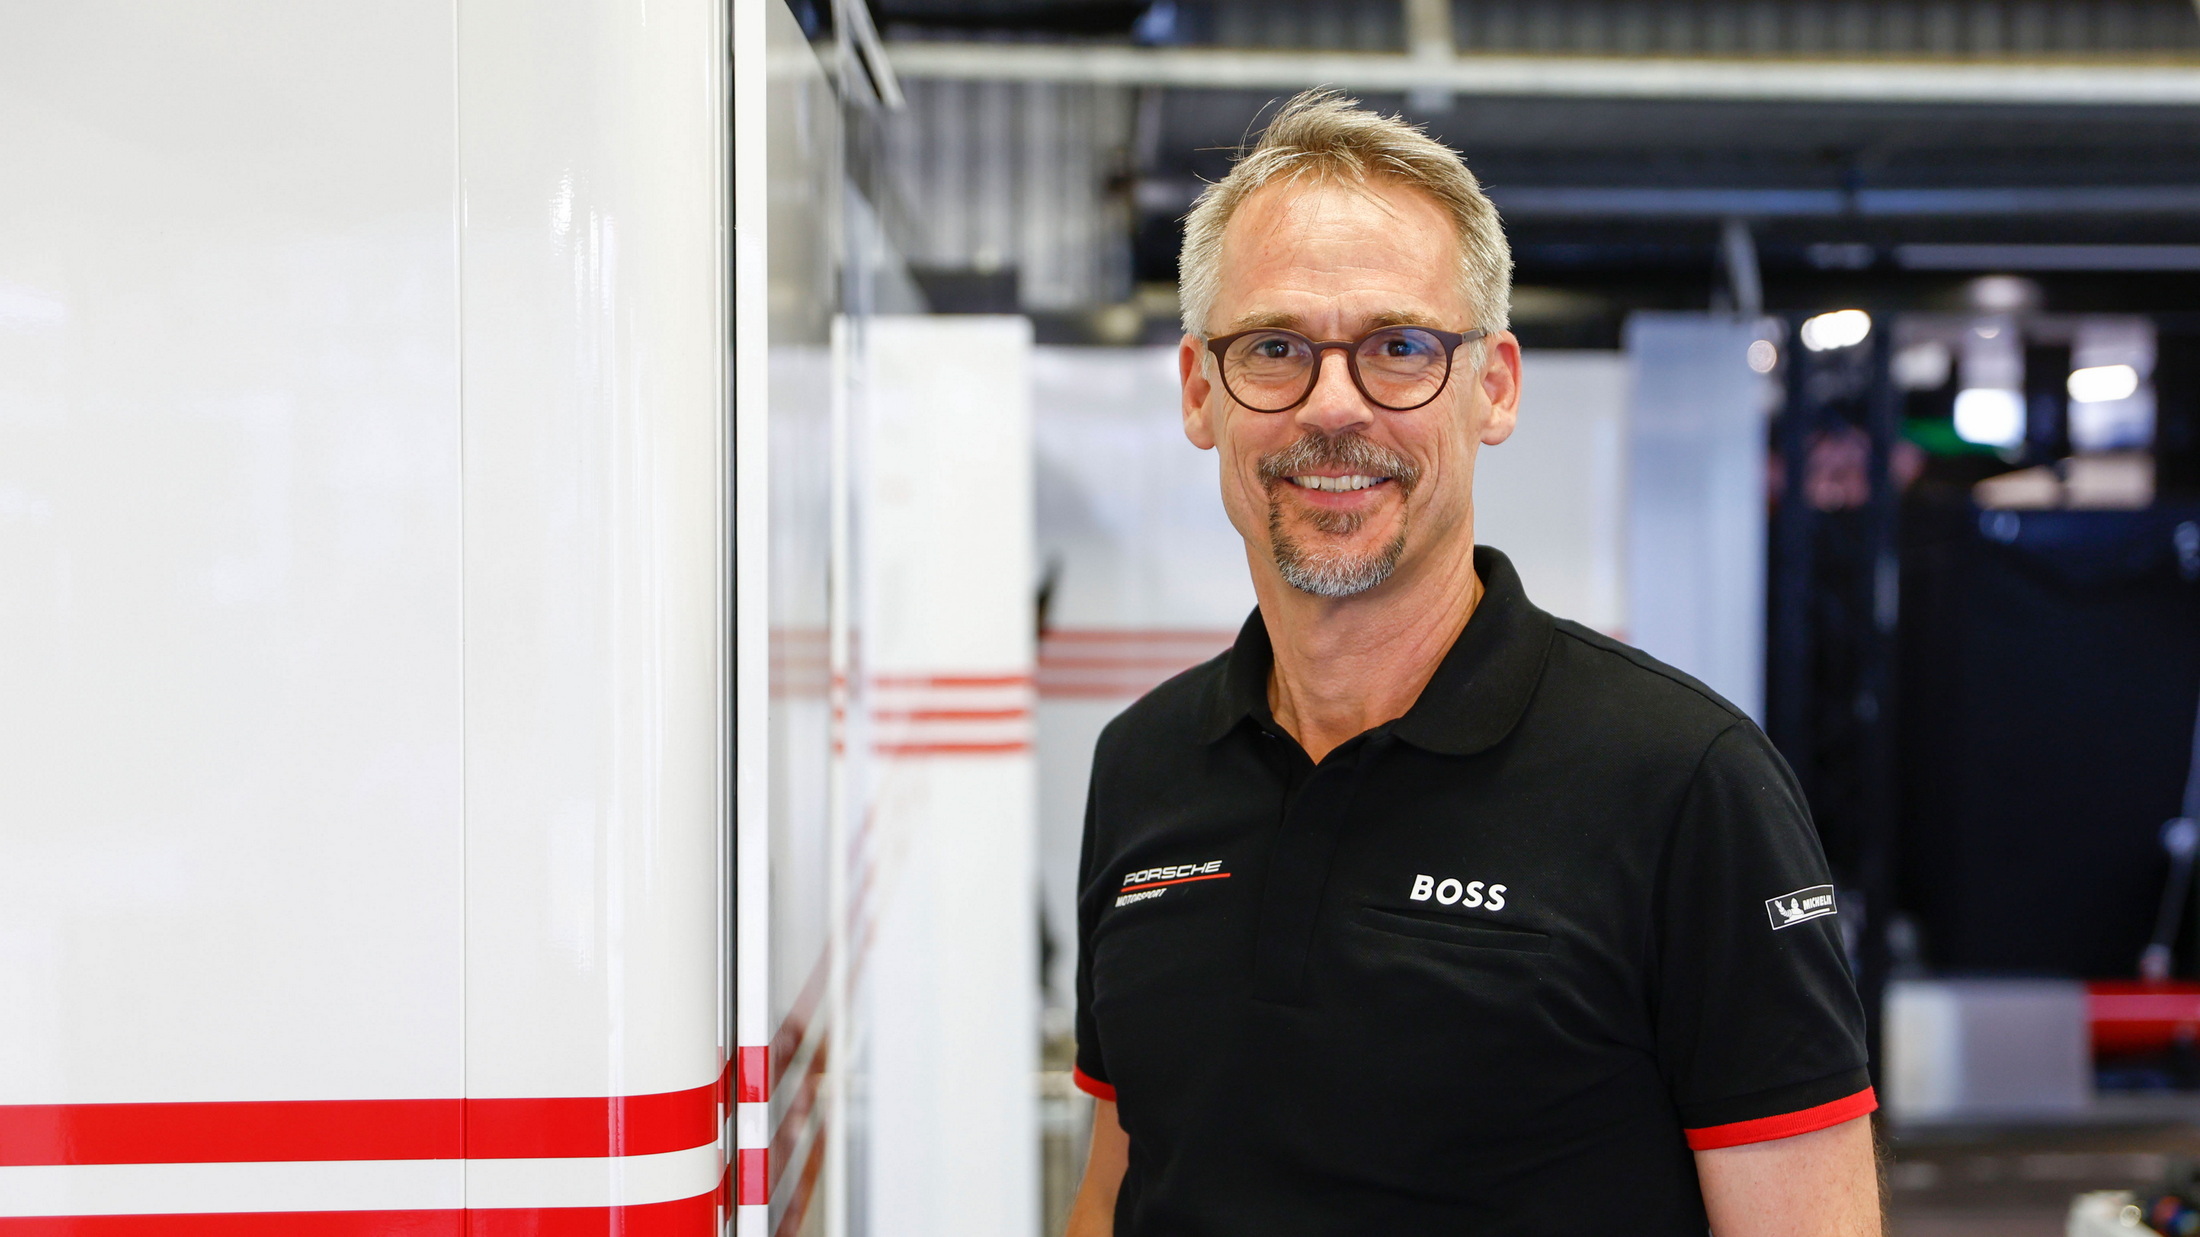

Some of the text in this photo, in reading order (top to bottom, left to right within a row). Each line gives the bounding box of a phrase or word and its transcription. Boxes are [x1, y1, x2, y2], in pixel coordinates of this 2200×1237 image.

[1123, 860, 1222, 886] PORSCHE
[1115, 888, 1167, 907] MOTORSPORT
[1409, 874, 1508, 911] BOSS
[1802, 894, 1832, 911] MICHELIN
